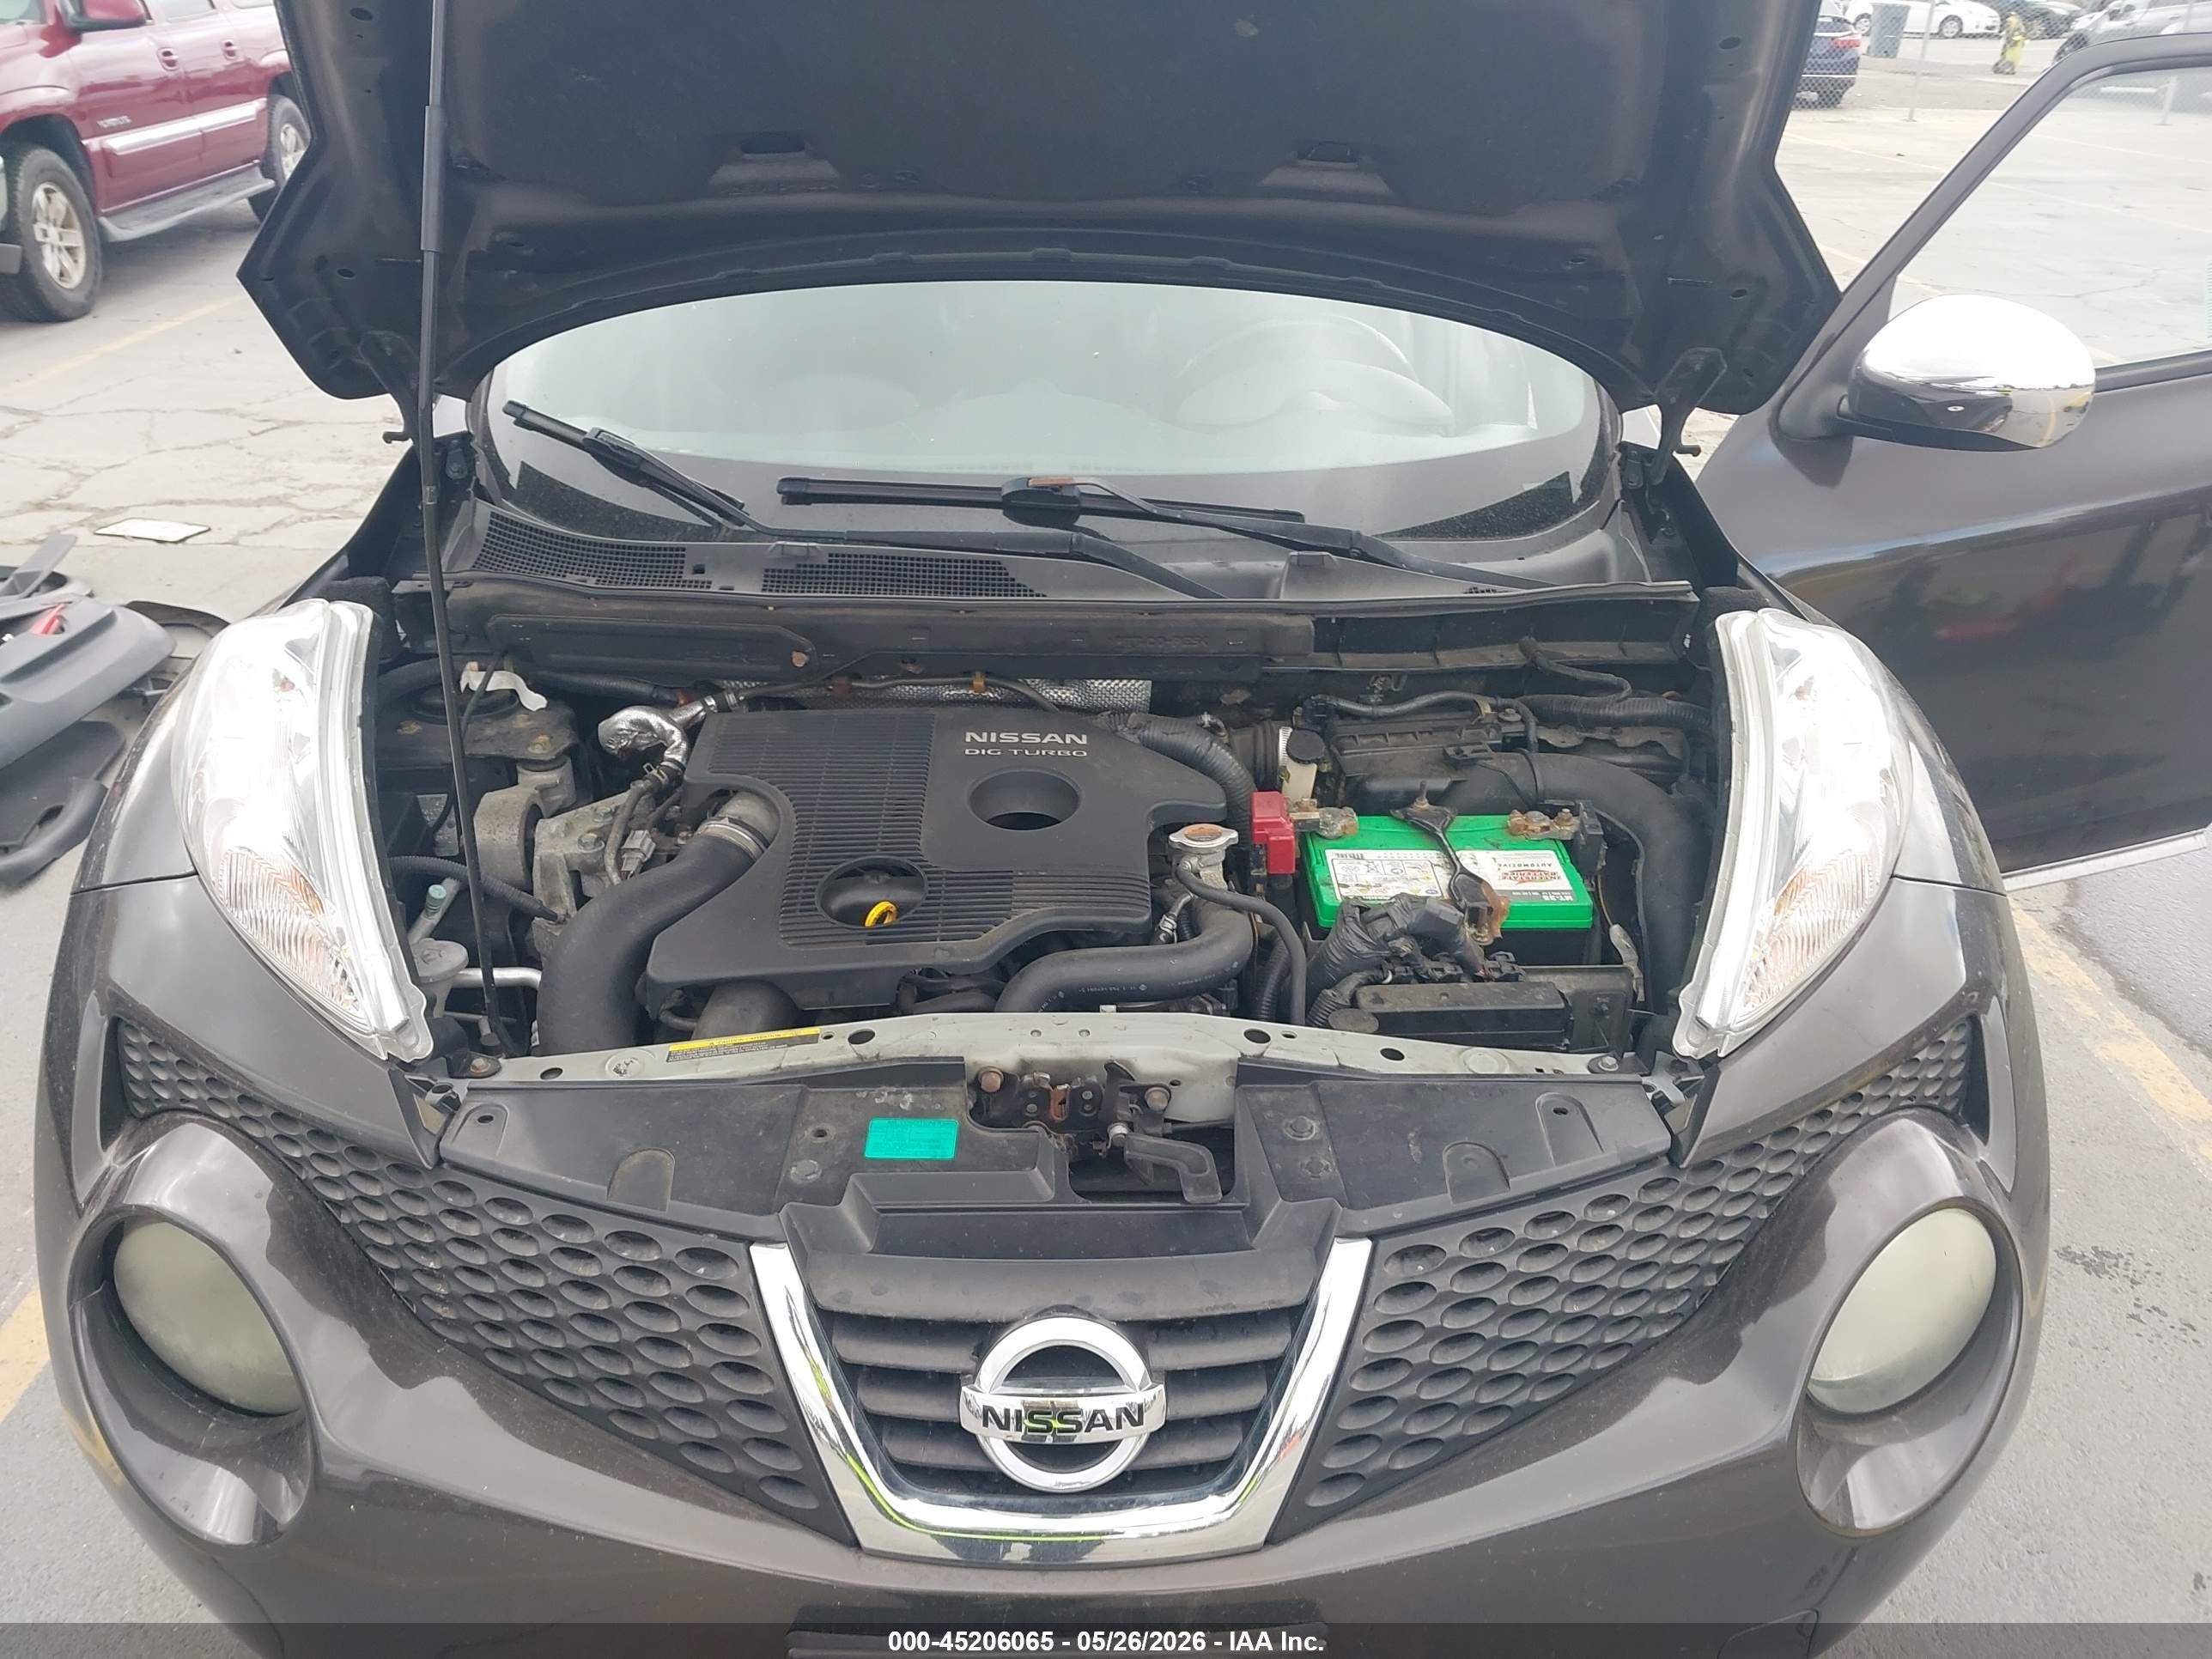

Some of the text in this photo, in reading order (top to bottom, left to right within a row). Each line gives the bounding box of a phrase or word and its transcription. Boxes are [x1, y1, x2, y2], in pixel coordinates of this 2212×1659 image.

[964, 732, 1087, 744] NISSAN
[1008, 749, 1087, 757] TURBO
[981, 1403, 1144, 1434] NISSAN
